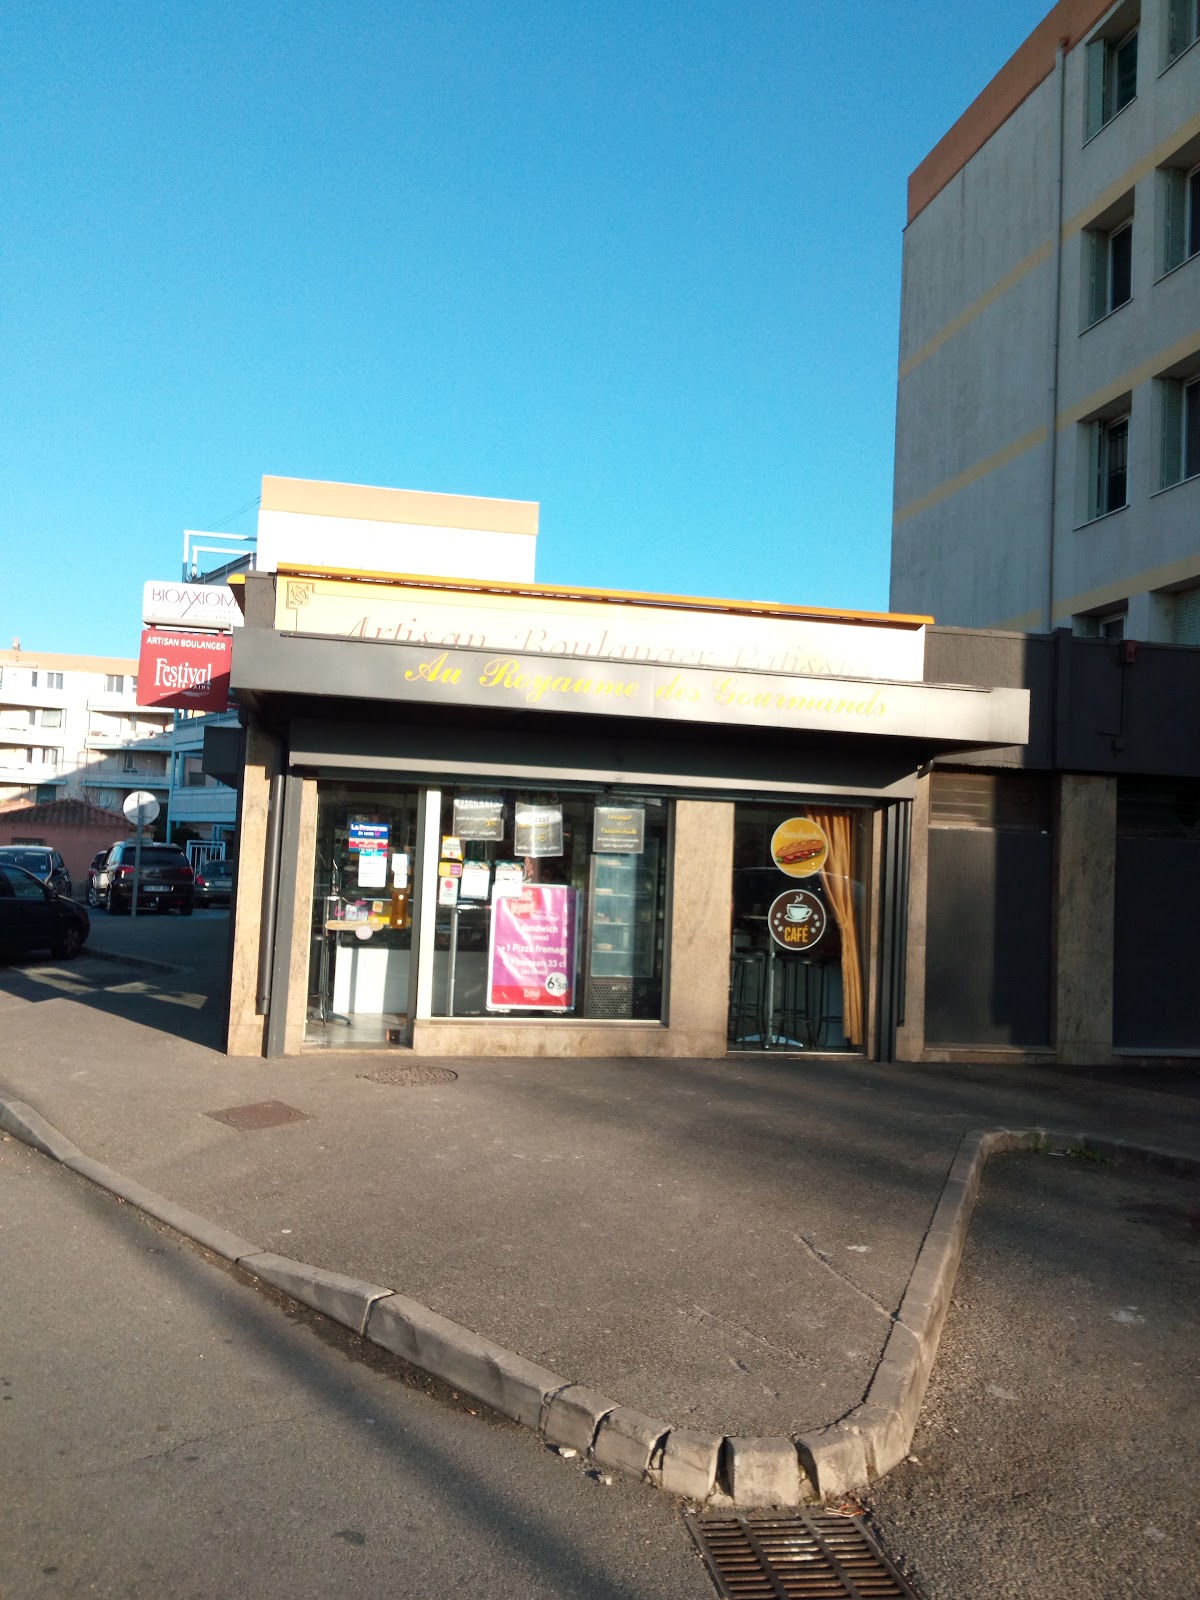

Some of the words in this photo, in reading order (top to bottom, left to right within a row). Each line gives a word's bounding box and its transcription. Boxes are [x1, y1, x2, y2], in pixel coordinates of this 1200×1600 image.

[147, 636, 180, 647] ARTISAN
[180, 639, 226, 651] BOULANGER
[154, 657, 213, 687] Festival
[404, 652, 462, 686] Au
[478, 657, 639, 704] Royaume
[655, 673, 700, 704] des
[713, 676, 888, 718] Gourmands
[784, 925, 809, 943] CAFÉ
